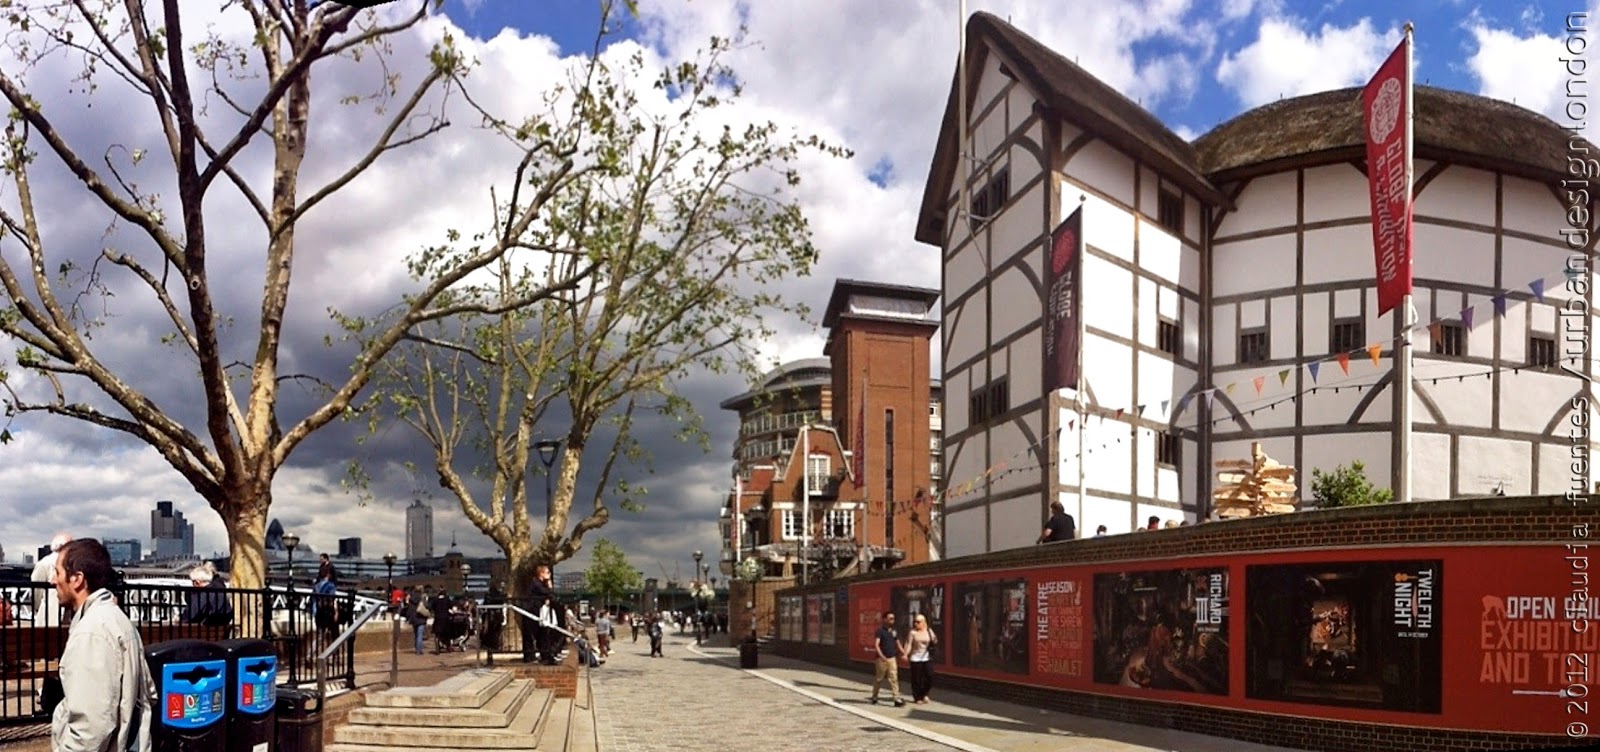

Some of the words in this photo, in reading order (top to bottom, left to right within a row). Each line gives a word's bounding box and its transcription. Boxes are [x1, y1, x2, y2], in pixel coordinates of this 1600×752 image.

[1387, 137, 1404, 204] GLOBE
[1048, 581, 1073, 594] SEASON
[1210, 574, 1222, 624] RICHARD
[1395, 582, 1412, 627] NIGHT
[1418, 569, 1432, 628] TWELFTH
[1037, 582, 1049, 641] THEATRE
[1195, 597, 1209, 624] III
[1506, 596, 1556, 619] OPEN
[1038, 642, 1049, 672] 2012
[1480, 652, 1530, 684] AND
